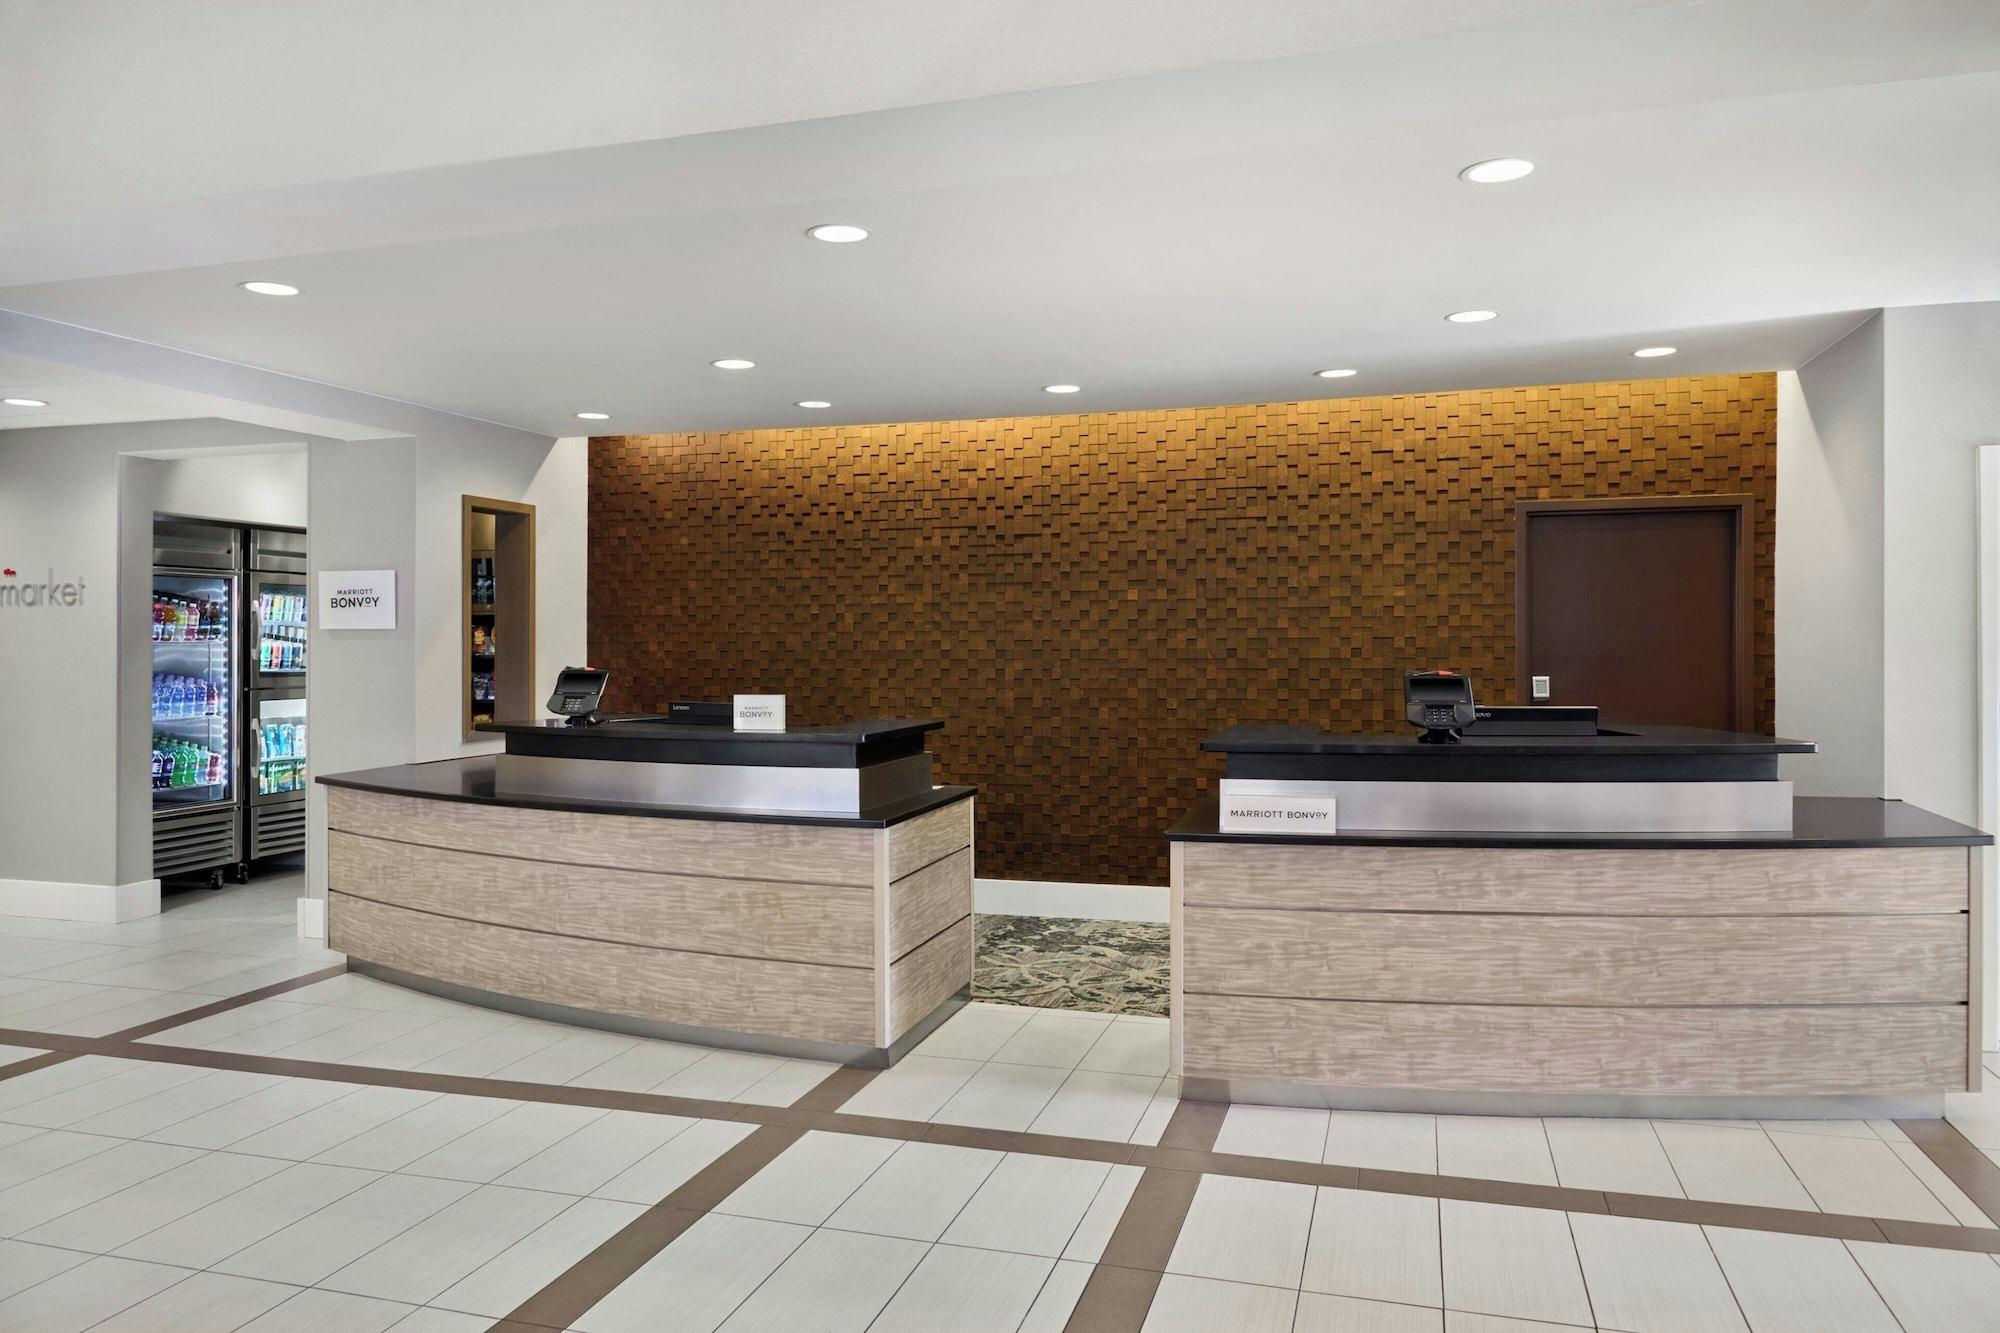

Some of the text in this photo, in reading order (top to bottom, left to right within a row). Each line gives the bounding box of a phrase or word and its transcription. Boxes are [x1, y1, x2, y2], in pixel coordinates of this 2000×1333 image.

[0, 567, 86, 607] market
[337, 588, 373, 596] MARRIOTT
[330, 596, 380, 609] BONVOY
[1230, 809, 1328, 819] MARRIOTT BONVOY
